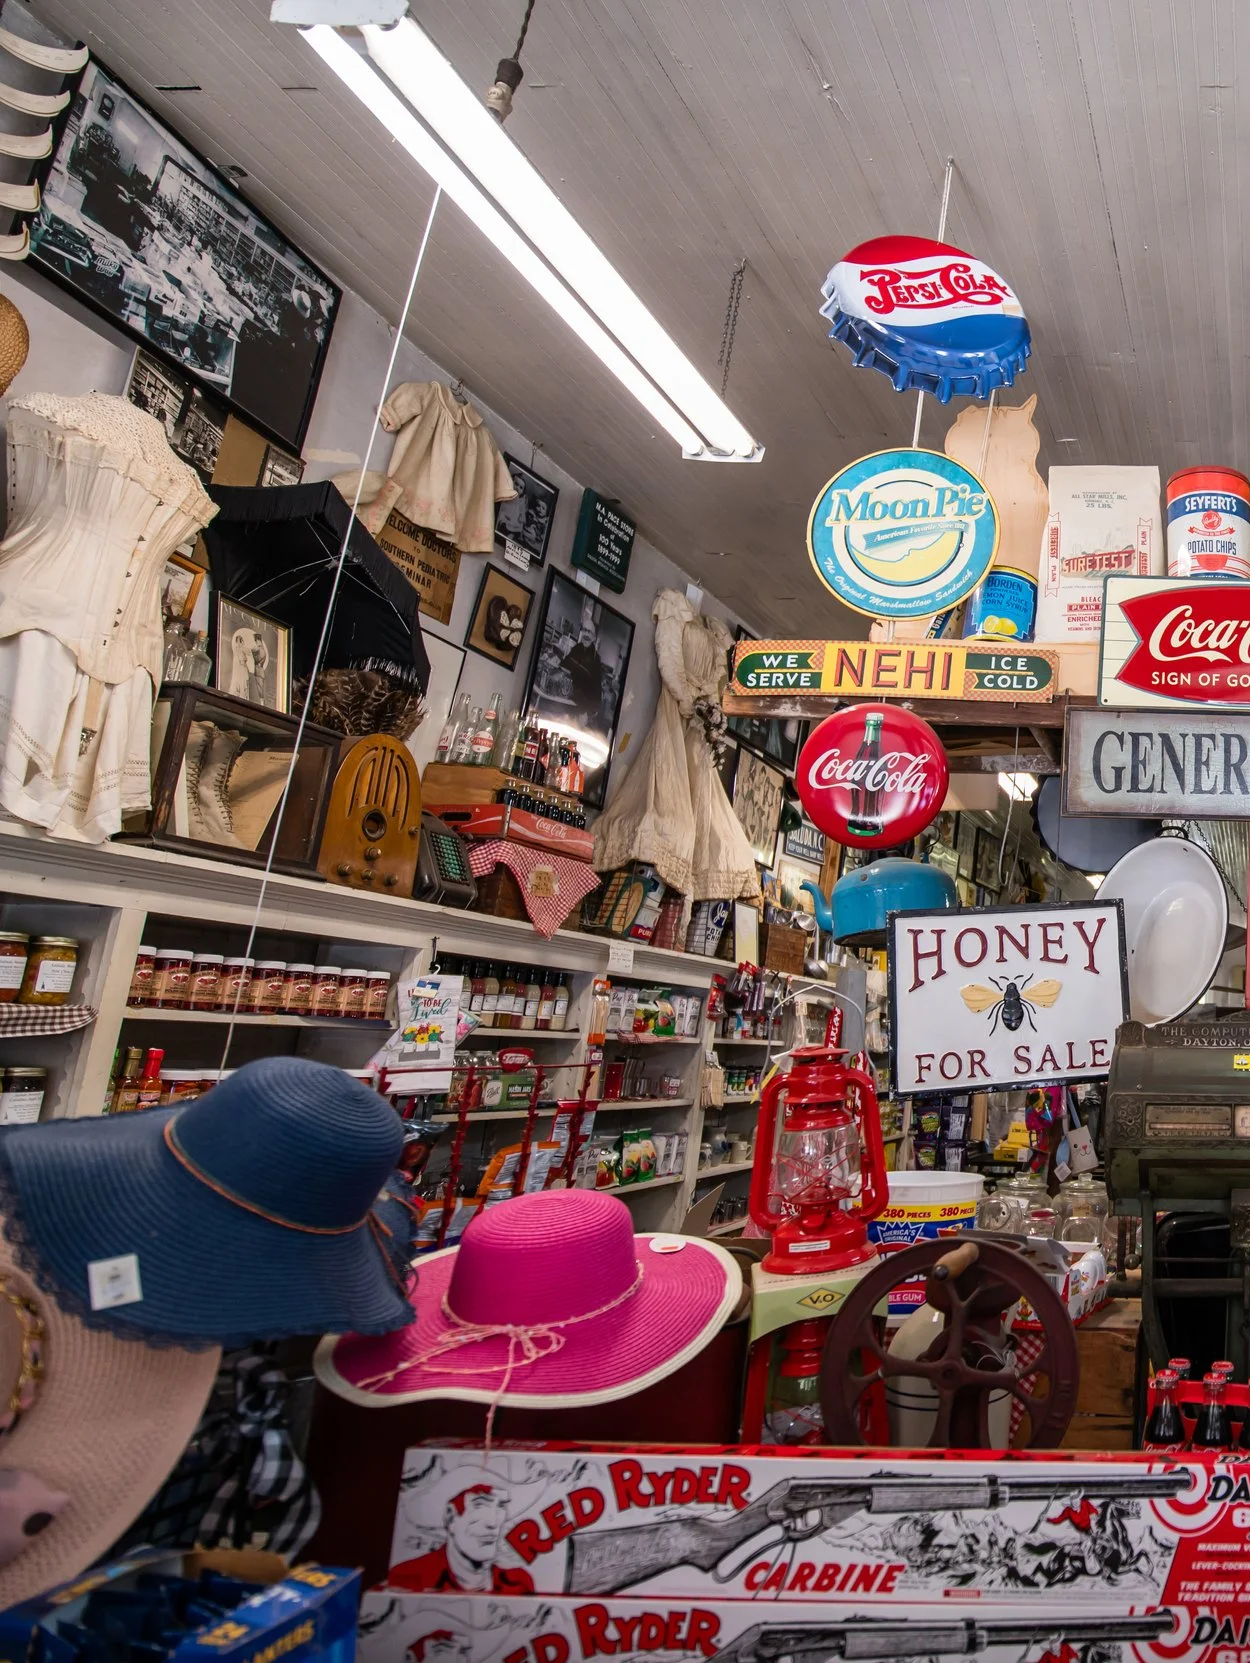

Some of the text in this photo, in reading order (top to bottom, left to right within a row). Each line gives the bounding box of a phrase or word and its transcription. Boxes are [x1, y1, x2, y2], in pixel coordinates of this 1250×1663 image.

[1185, 496, 1237, 512] SEYFERT'S
[1188, 539, 1237, 555] POTATO CHIPS
[380, 538, 451, 584] SOUTHERN PEDIATRIC
[1063, 550, 1137, 573] SURETEST
[823, 557, 973, 609] The Original Marshmallow Sandwich
[988, 576, 1023, 592] BORDEN
[1005, 601, 1029, 613] SYRUP
[1009, 595, 1029, 607] JUICE
[762, 654, 798, 668] WE
[990, 656, 1028, 670] ICE
[833, 648, 954, 690] NEHI
[746, 673, 811, 686] SERVE
[983, 674, 1039, 689] COLD
[1151, 671, 1191, 686] SIGN
[1198, 672, 1219, 686] OF
[808, 748, 931, 794] Coca-Cola
[907, 917, 1106, 993] HONEY
[1161, 1027, 1187, 1037] THE
[1182, 1038, 1241, 1048] DAYTON,
[915, 1039, 1112, 1084] FOR SALE
[884, 1206, 959, 1219] 380 PIECES 380
[882, 1228, 916, 1238] AMERICA'S
[884, 1235, 911, 1243] ORIGINAL
[902, 1292, 922, 1303] GUM
[505, 1458, 751, 1564] RED RYDER
[1197, 1544, 1242, 1552] MAXIMUM
[743, 1561, 905, 1593] CARBINE
[1180, 1582, 1200, 1592] THE
[1202, 1582, 1242, 1592] FAMILY
[1177, 1592, 1236, 1603] TRADITION
[574, 1602, 722, 1657] RYDER
